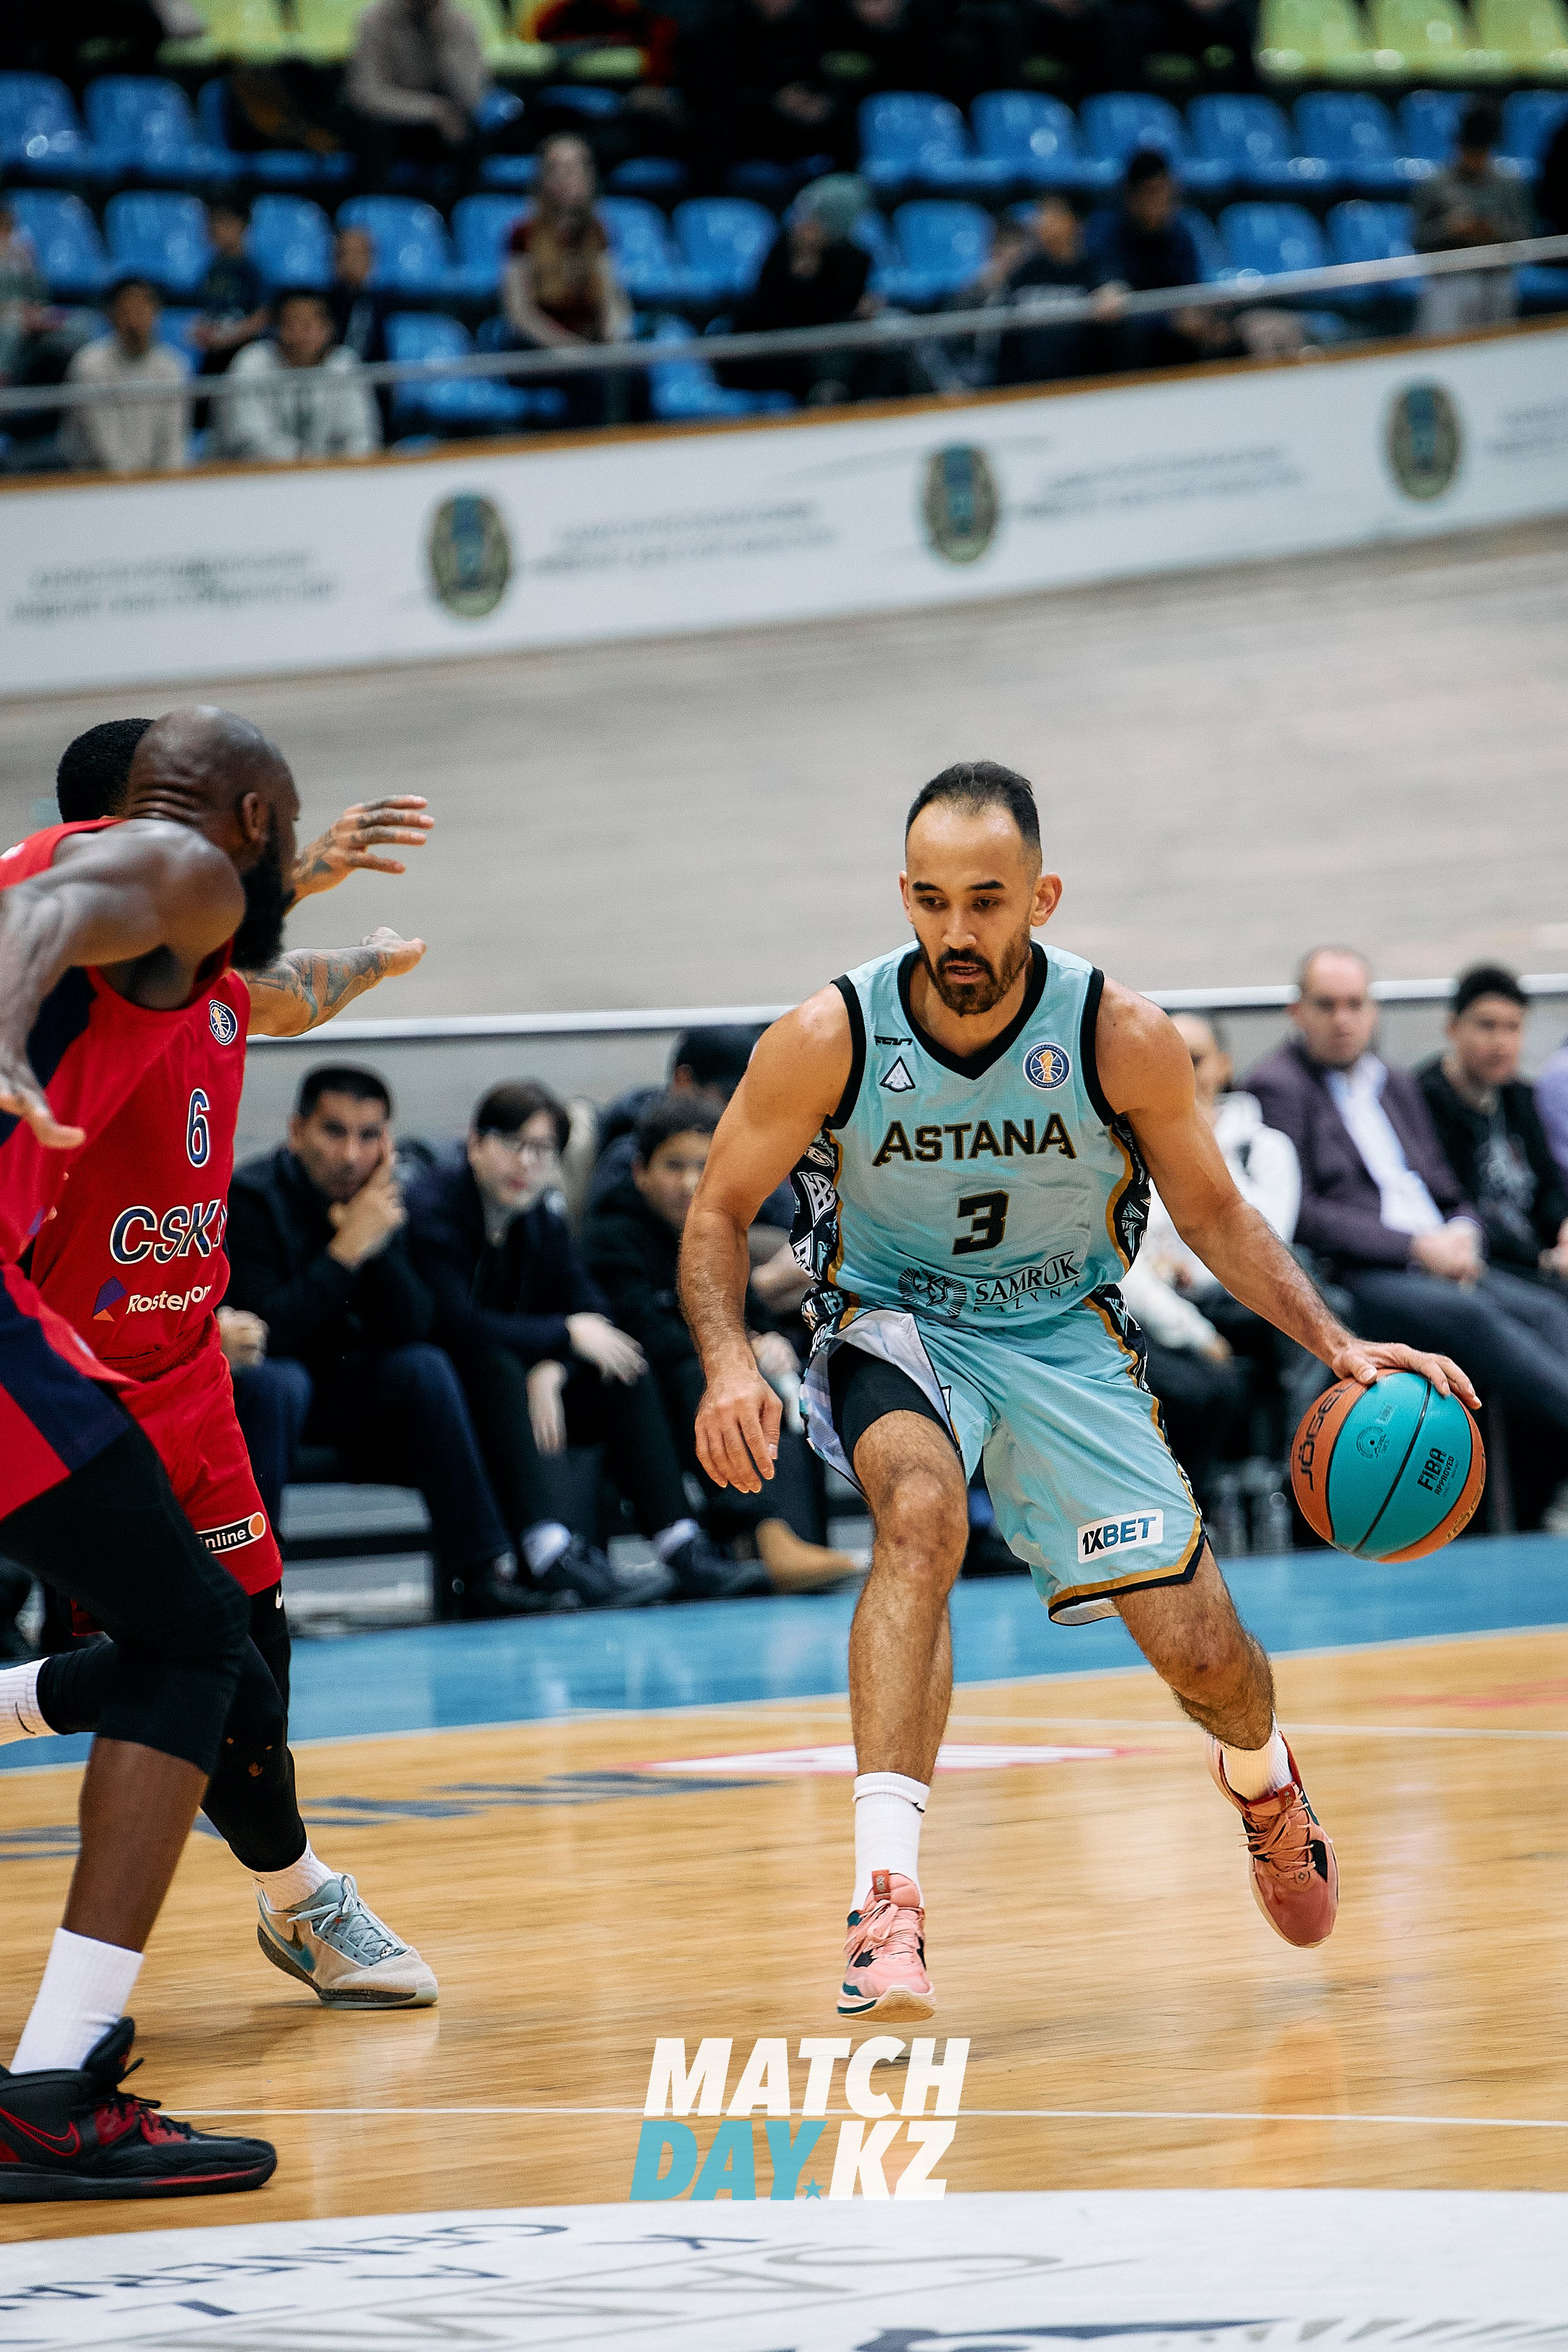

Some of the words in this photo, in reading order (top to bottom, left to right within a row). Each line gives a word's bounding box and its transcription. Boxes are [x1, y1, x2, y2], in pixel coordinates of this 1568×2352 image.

[186, 1088, 210, 1167] 6
[873, 1113, 1077, 1166] ASTANA
[952, 1190, 1009, 1256] 3
[975, 1254, 1080, 1302] SAMRUK
[1417, 1448, 1447, 1491] FIBA
[1434, 1455, 1455, 1496] APPROVED
[1082, 1516, 1157, 1555] 1XBET
